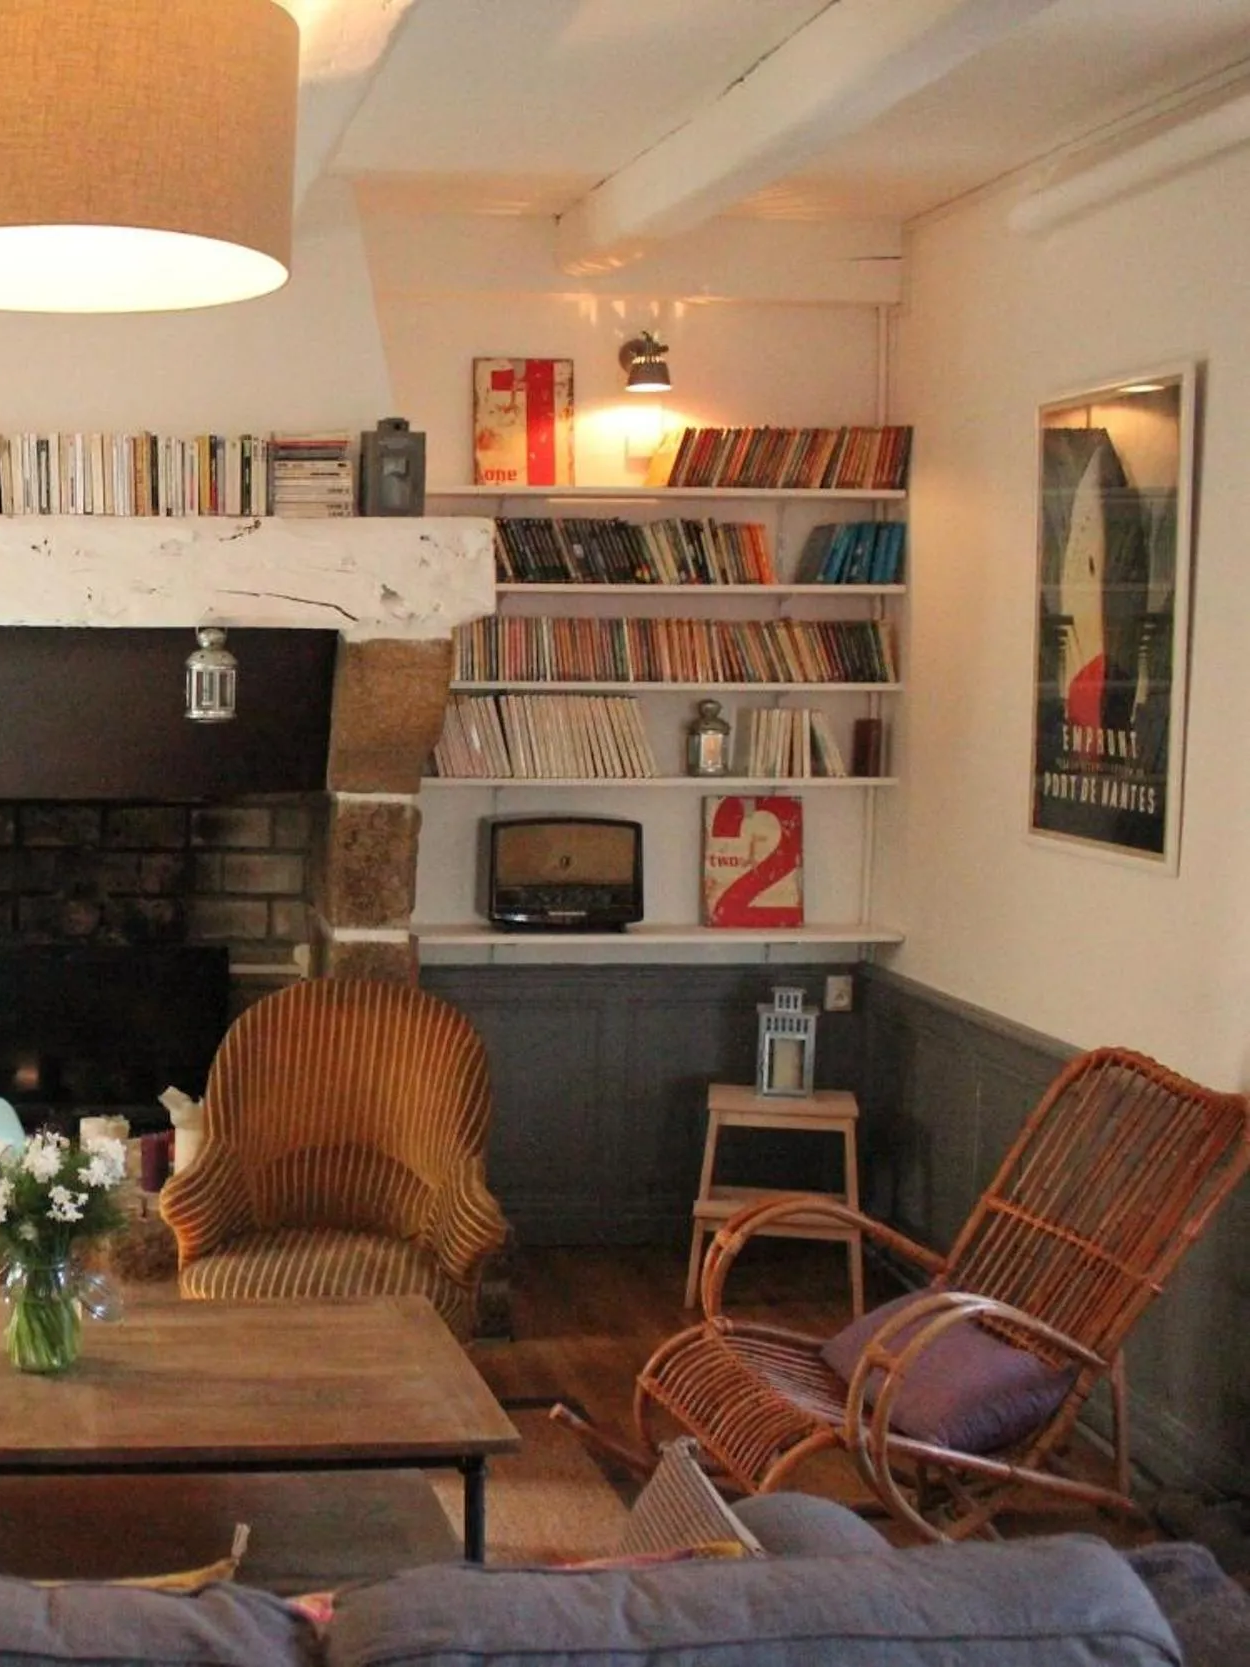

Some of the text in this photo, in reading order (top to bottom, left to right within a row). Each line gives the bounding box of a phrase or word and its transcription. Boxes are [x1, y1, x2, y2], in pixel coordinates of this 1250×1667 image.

[484, 468, 518, 484] one
[1062, 723, 1138, 759] EMPRUNT
[1043, 770, 1156, 815] PORT DE NANTES
[709, 854, 740, 868] two
[711, 796, 803, 928] 2
